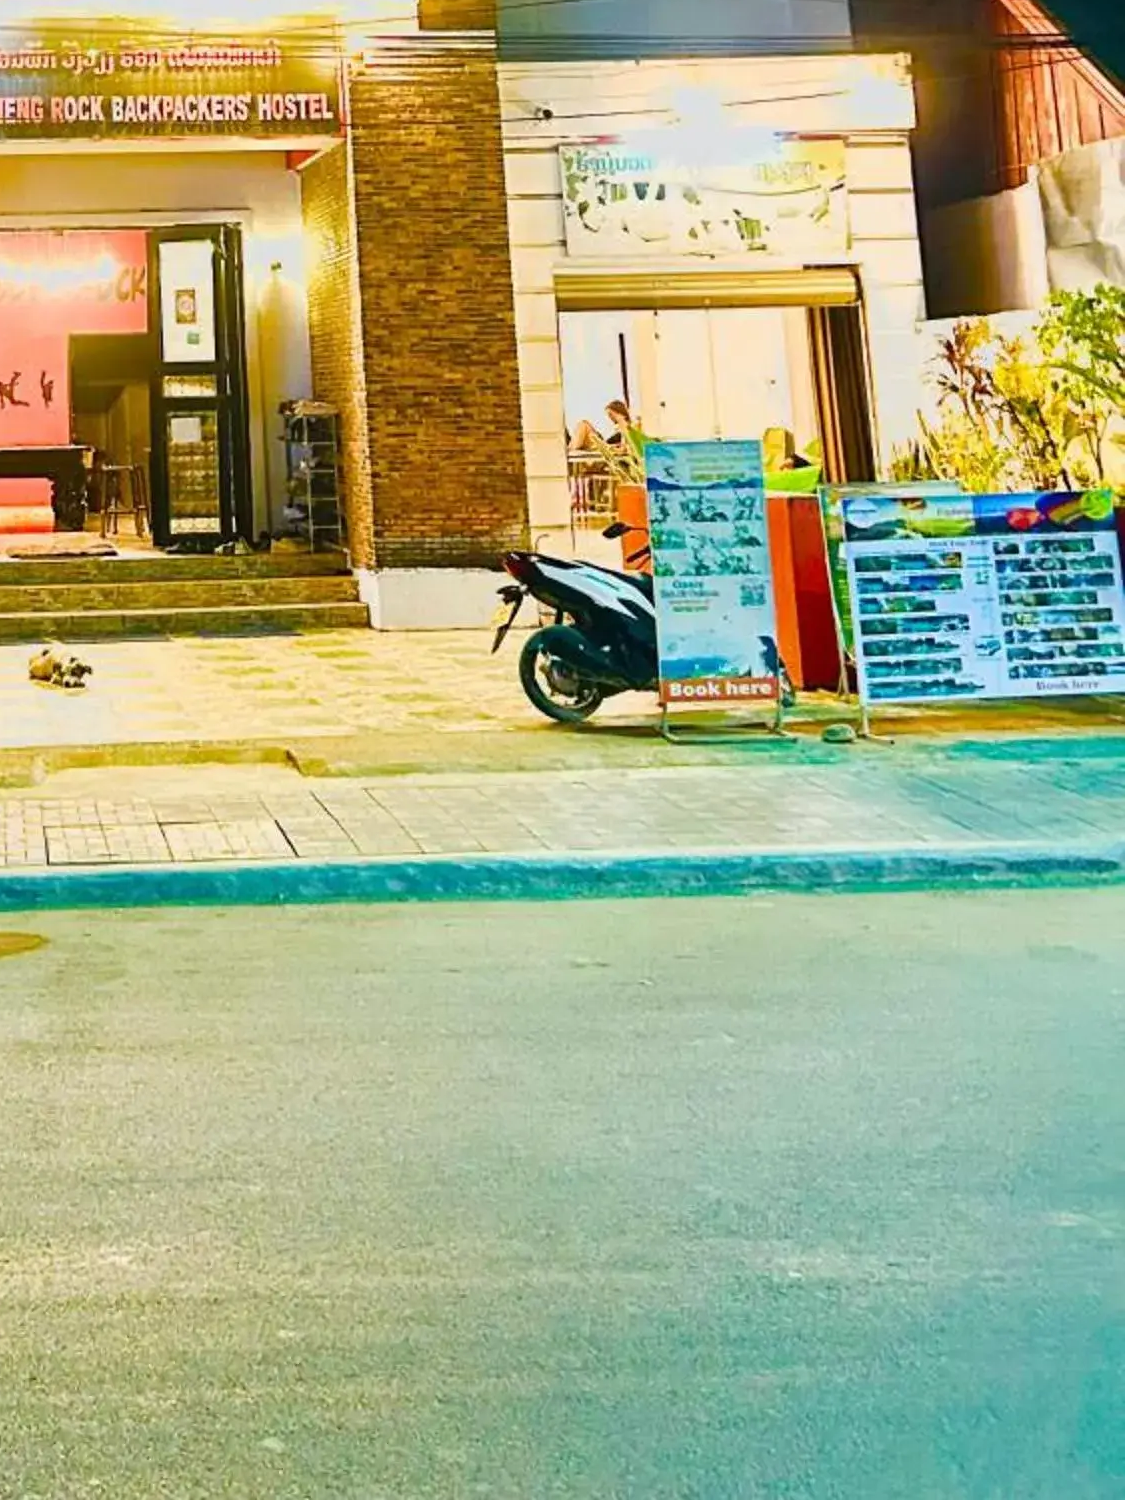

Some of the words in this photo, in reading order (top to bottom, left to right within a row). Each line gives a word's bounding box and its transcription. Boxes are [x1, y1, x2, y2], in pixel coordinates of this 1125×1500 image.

[51, 95, 105, 122] ROCK
[258, 93, 333, 121] HOSTEL
[670, 681, 721, 698] Book
[725, 680, 772, 696] here
